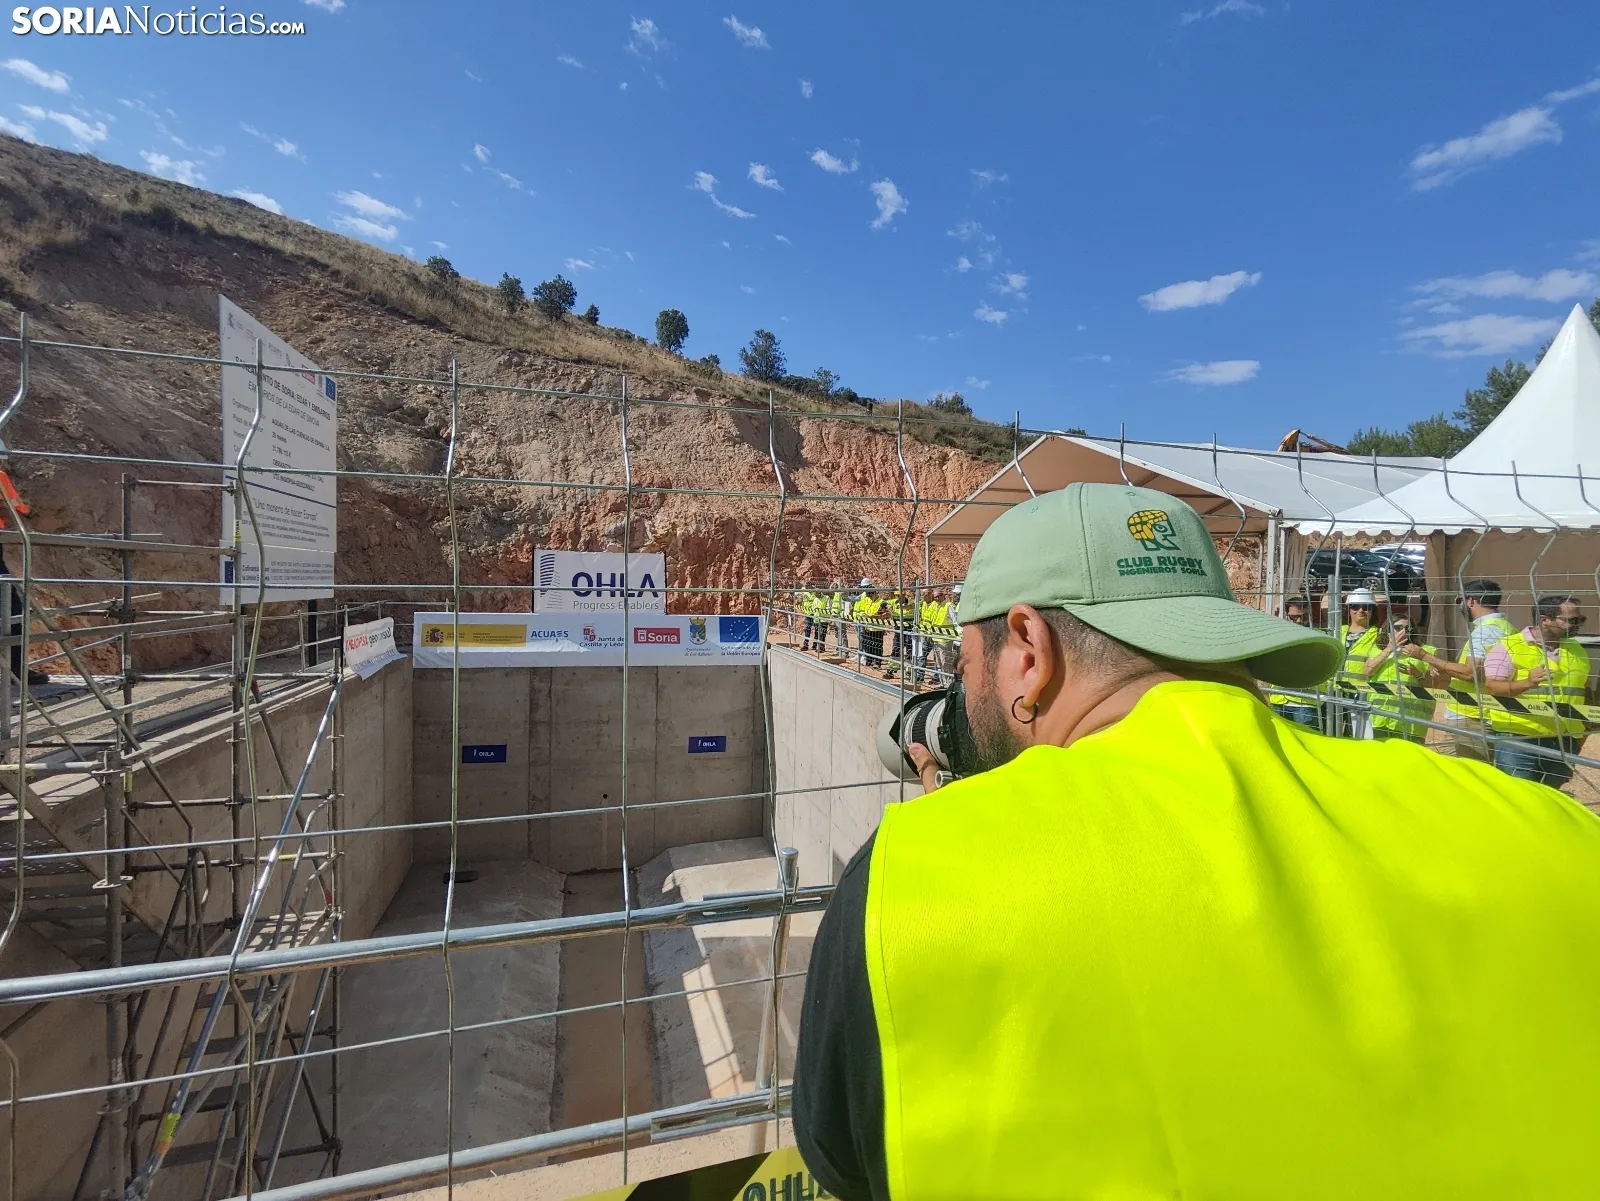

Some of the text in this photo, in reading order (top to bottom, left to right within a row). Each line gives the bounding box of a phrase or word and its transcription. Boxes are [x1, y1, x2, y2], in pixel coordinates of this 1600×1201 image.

[1116, 555, 1203, 569] CLUB RUGBY
[1118, 566, 1208, 577] INGENIEROS SORIA
[571, 571, 659, 598] OHLA
[573, 600, 659, 611] Progress Eablers
[531, 630, 569, 638] ACUAES
[648, 632, 678, 643] Soria
[478, 750, 495, 758] OHLA
